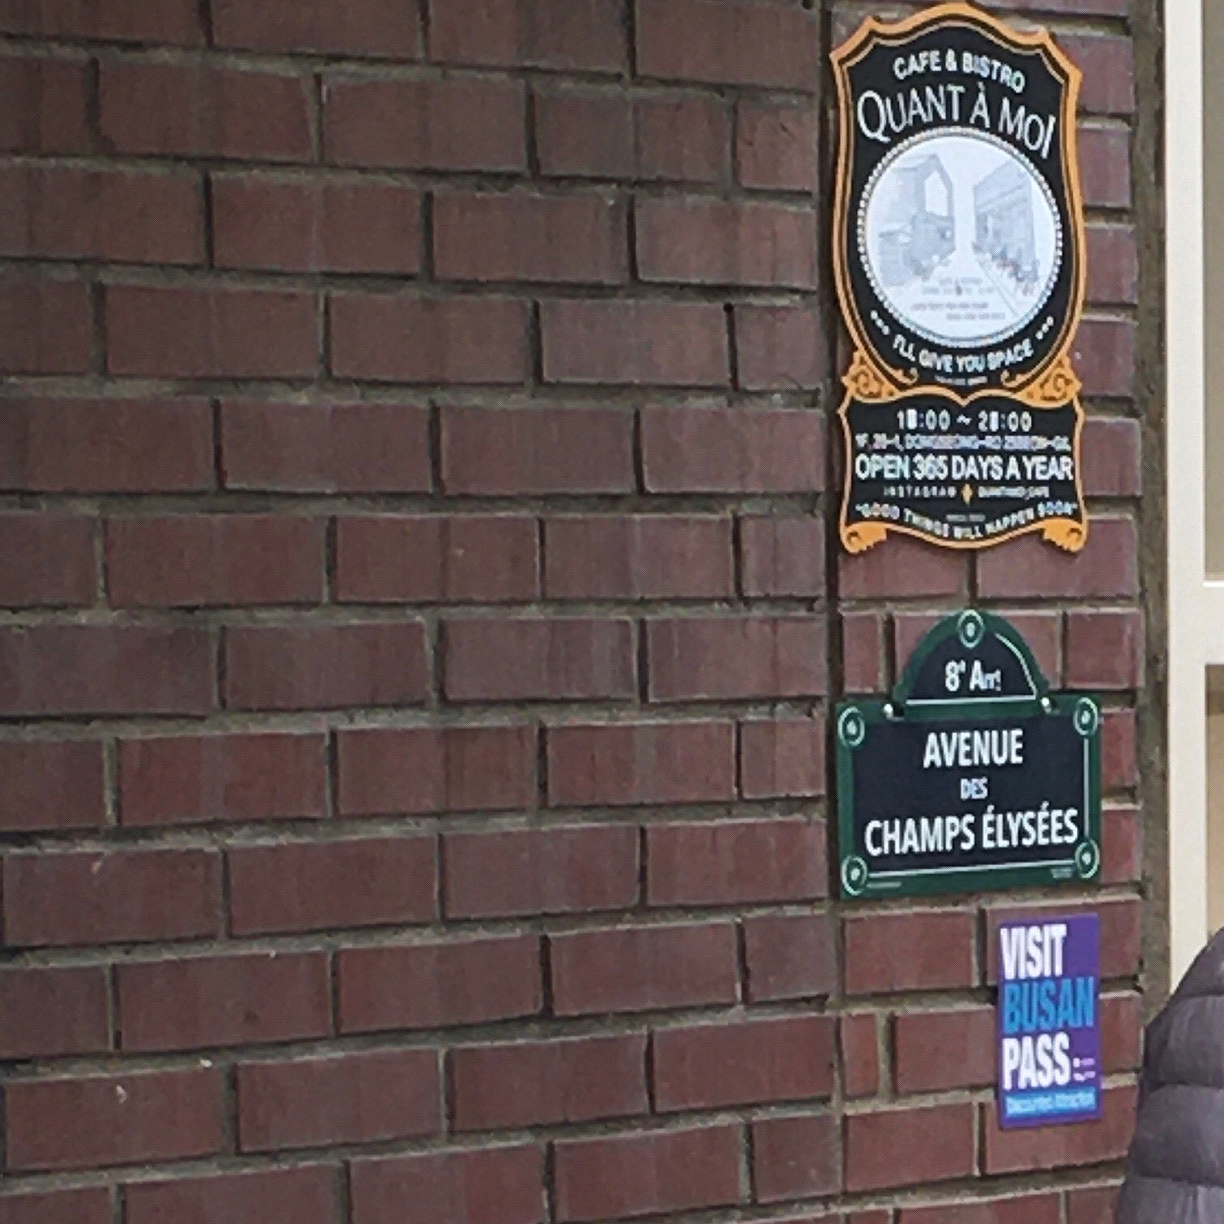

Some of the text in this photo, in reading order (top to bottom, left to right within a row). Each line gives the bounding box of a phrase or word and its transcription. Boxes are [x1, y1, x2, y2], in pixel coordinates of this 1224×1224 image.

[893, 49, 1026, 94] CAFE & BISTRO
[857, 81, 1057, 160] QUANT À MOI
[956, 353, 986, 373] YOU
[855, 453, 1074, 481] OPEN 365 DAYS A YEAR
[922, 728, 1024, 769] AVENUE
[959, 776, 989, 801] DES
[864, 800, 1079, 857] CHAMPS ÉLYSÉES
[1000, 923, 1068, 981] VISIT
[1004, 976, 1095, 1035] BUSAN
[1002, 1031, 1072, 1091] PASS
